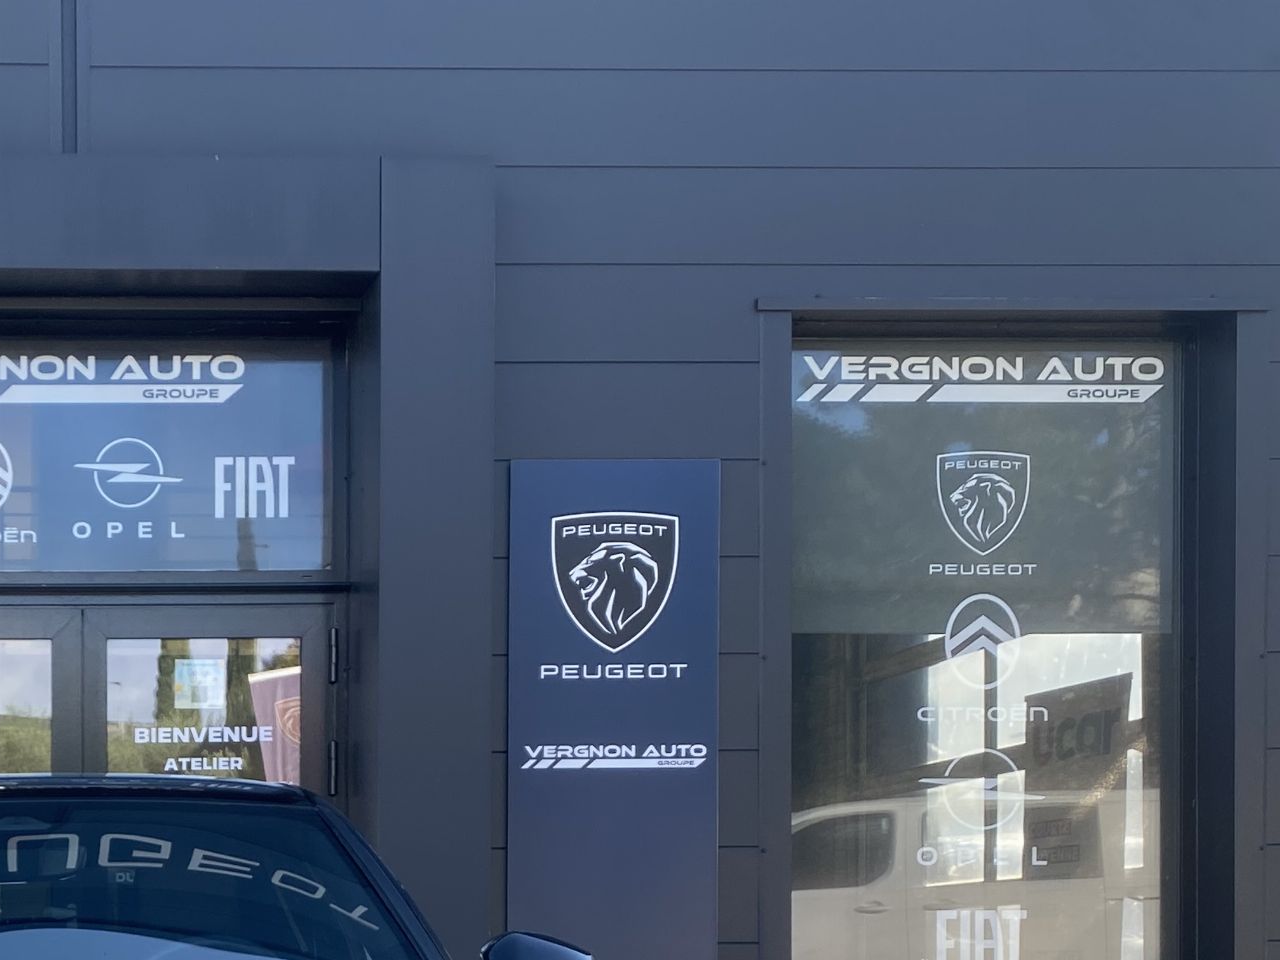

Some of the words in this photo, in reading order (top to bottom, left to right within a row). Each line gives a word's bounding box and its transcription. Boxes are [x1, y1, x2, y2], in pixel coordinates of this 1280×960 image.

[110, 354, 246, 381] AUTO
[803, 355, 1024, 382] VERGNON
[1035, 355, 1165, 382] AUTO
[142, 387, 220, 400] GROUPE
[1066, 387, 1141, 399] GROUPE
[944, 459, 1022, 471] PEUGEOT
[214, 455, 296, 519] FIAT
[71, 521, 185, 539] OPEL
[561, 523, 667, 538] PEUGEOT
[928, 563, 1038, 576] PEUGEOT
[540, 663, 688, 680] PEUGEOT
[133, 725, 274, 744] BIENVENUE
[524, 744, 636, 758] VERGNON
[641, 743, 708, 758] AUTO
[163, 756, 243, 772] ATELIER
